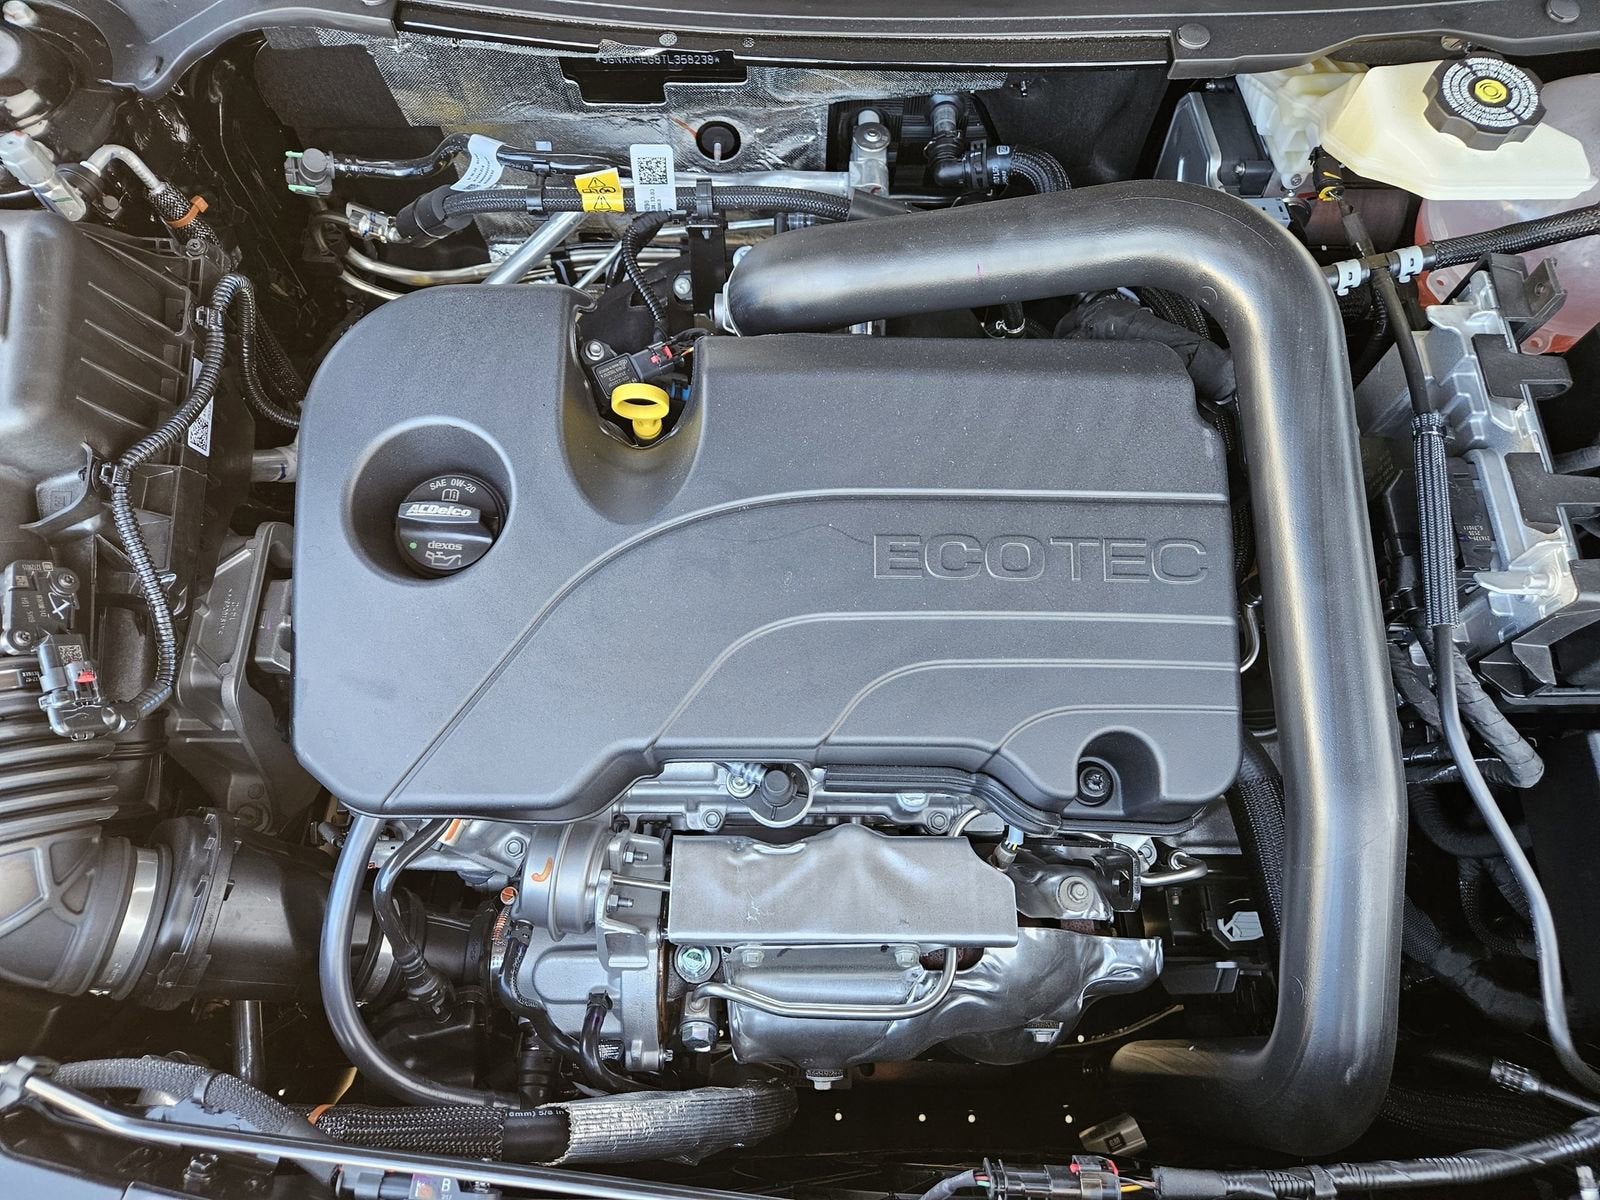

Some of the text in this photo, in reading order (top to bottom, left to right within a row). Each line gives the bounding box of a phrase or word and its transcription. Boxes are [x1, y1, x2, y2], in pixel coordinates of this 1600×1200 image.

[429, 478, 447, 491] SAE
[405, 504, 472, 517] ACDelco
[427, 540, 463, 551] dexos
[873, 533, 1208, 584] ECOTEC
[441, 1177, 451, 1191] B
